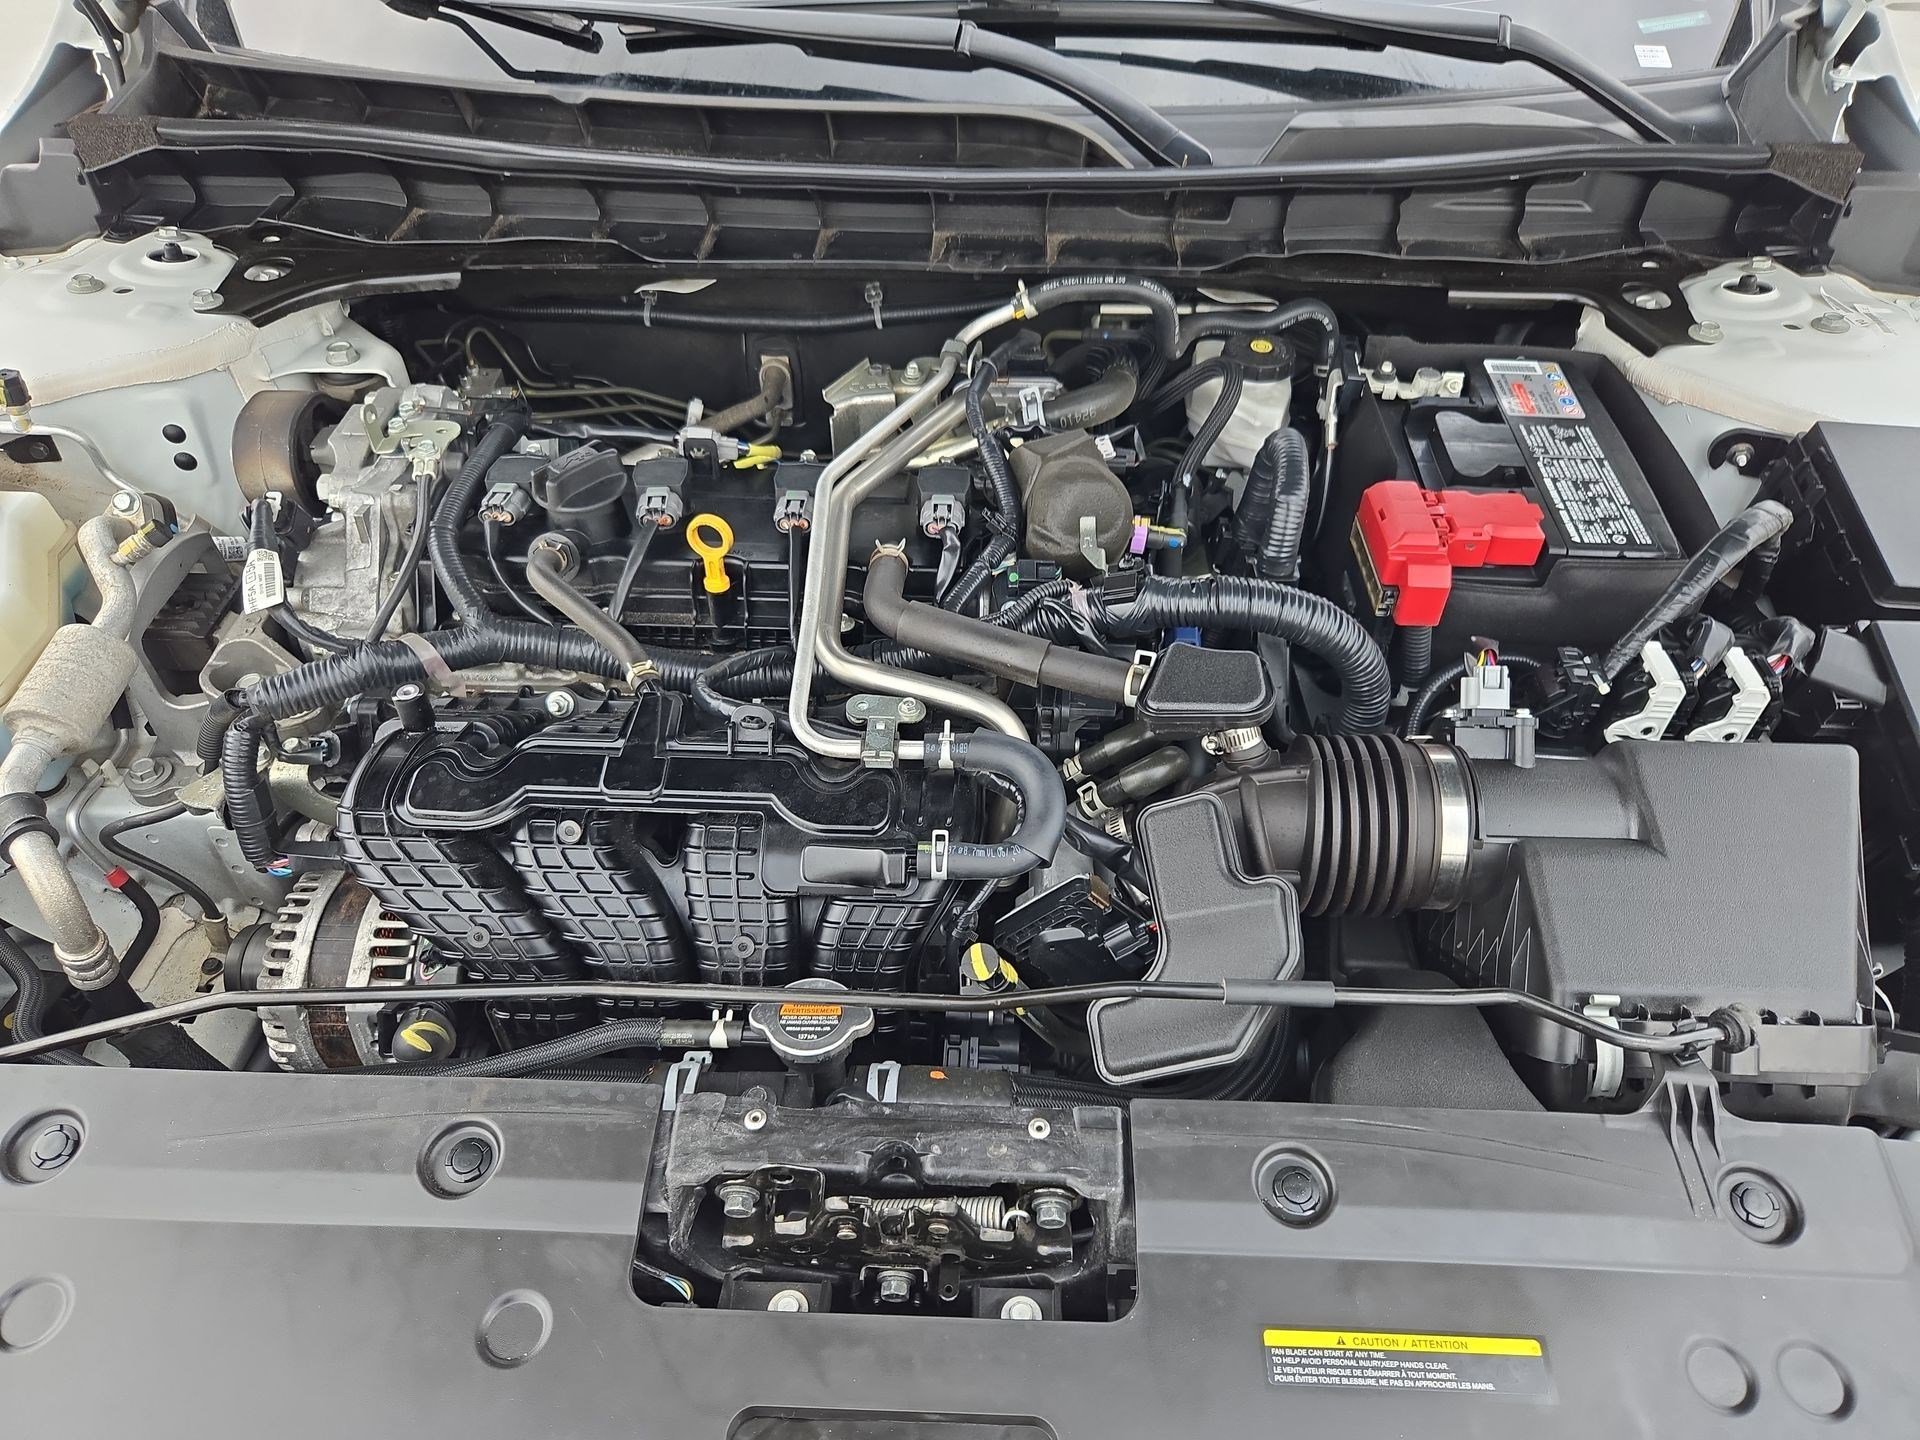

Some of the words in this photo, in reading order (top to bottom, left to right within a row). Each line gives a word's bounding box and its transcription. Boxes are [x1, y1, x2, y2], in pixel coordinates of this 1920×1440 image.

[1060, 409, 1097, 428] 92410
[1352, 1337, 1399, 1347] CAUTION
[1412, 1340, 1468, 1350] ATTENTION
[1286, 1348, 1307, 1356] BLADE
[1322, 1358, 1358, 1366] PERSONAL
[1426, 1362, 1449, 1370] CLEAR.
[1282, 1366, 1326, 1375] VENTILATEUR
[1326, 1368, 1352, 1376] RISQUE
[1364, 1368, 1400, 1378] DÉMARRER
[1401, 1369, 1406, 1378] À
[1407, 1371, 1425, 1379] TOUT
[1426, 1372, 1458, 1380] MOMENT.
[1295, 1374, 1318, 1383] ÉVITER
[1319, 1376, 1340, 1384] TOUTE
[1342, 1378, 1378, 1386] BLESSURE,
[1415, 1380, 1457, 1389] APPROCHER
[1458, 1382, 1471, 1390] LES
[1472, 1382, 1496, 1391] MAINS.
